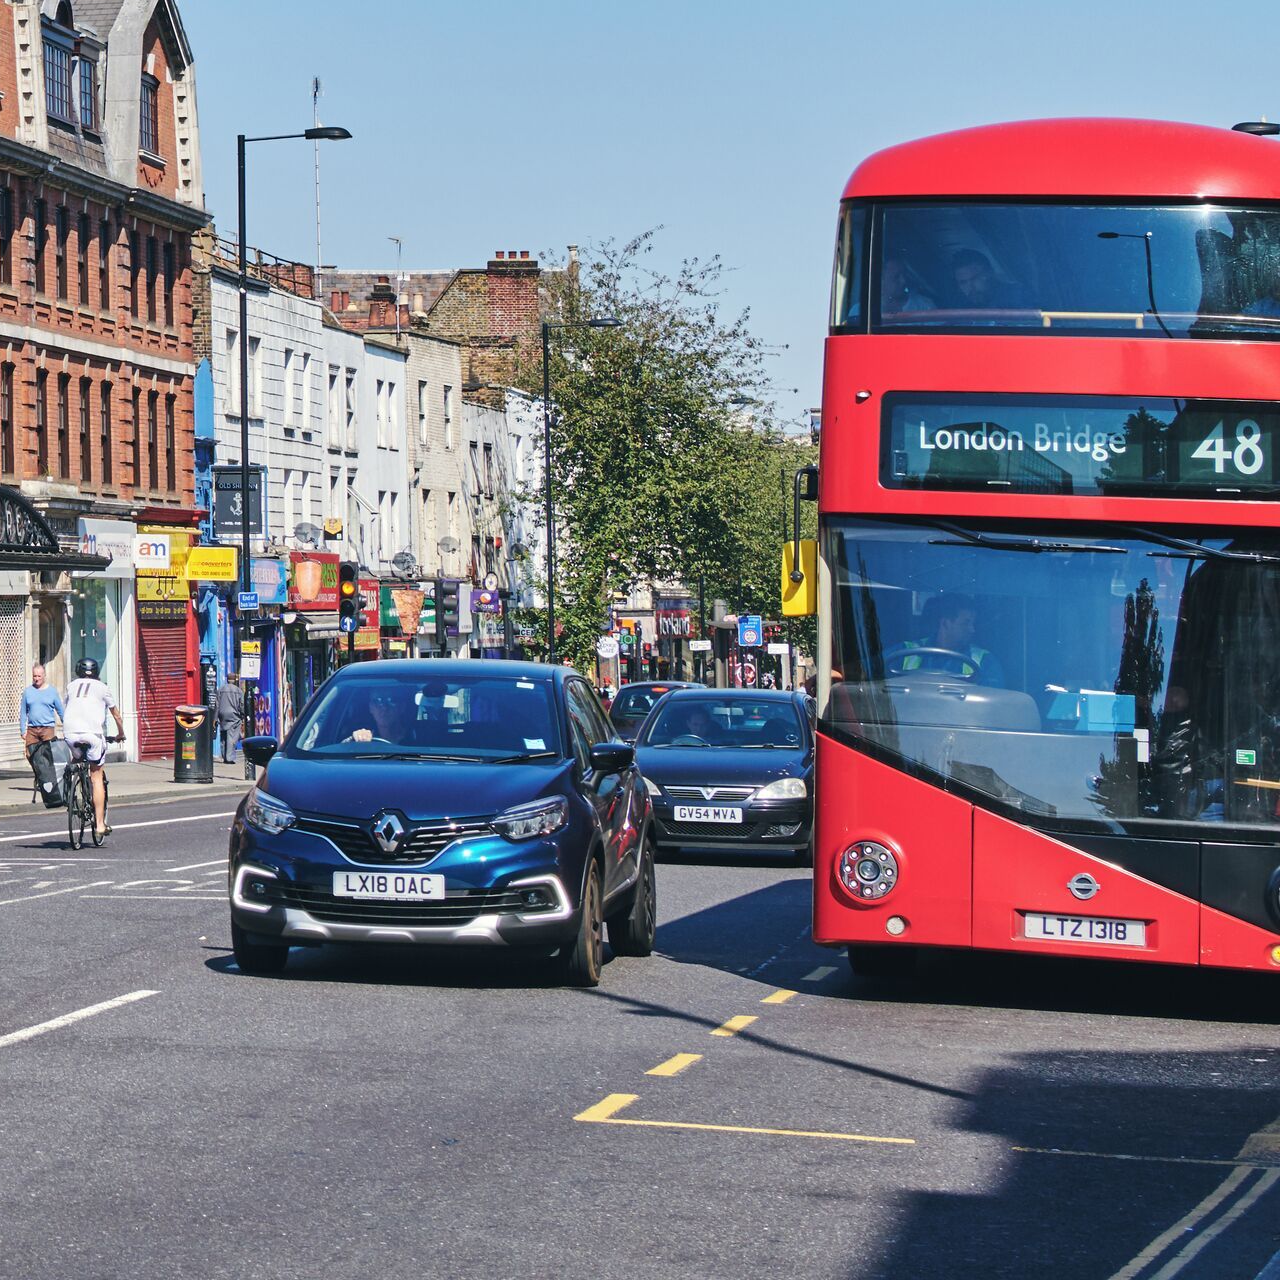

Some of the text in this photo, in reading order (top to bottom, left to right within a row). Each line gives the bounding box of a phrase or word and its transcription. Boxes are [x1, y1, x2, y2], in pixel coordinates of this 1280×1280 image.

[919, 420, 1127, 462] London Bridge
[1191, 419, 1264, 475] 48
[139, 542, 166, 556] am
[680, 808, 736, 820] GV54 MVA
[345, 875, 432, 894] LX18 OAC
[1042, 917, 1127, 940] LTZ 1318
